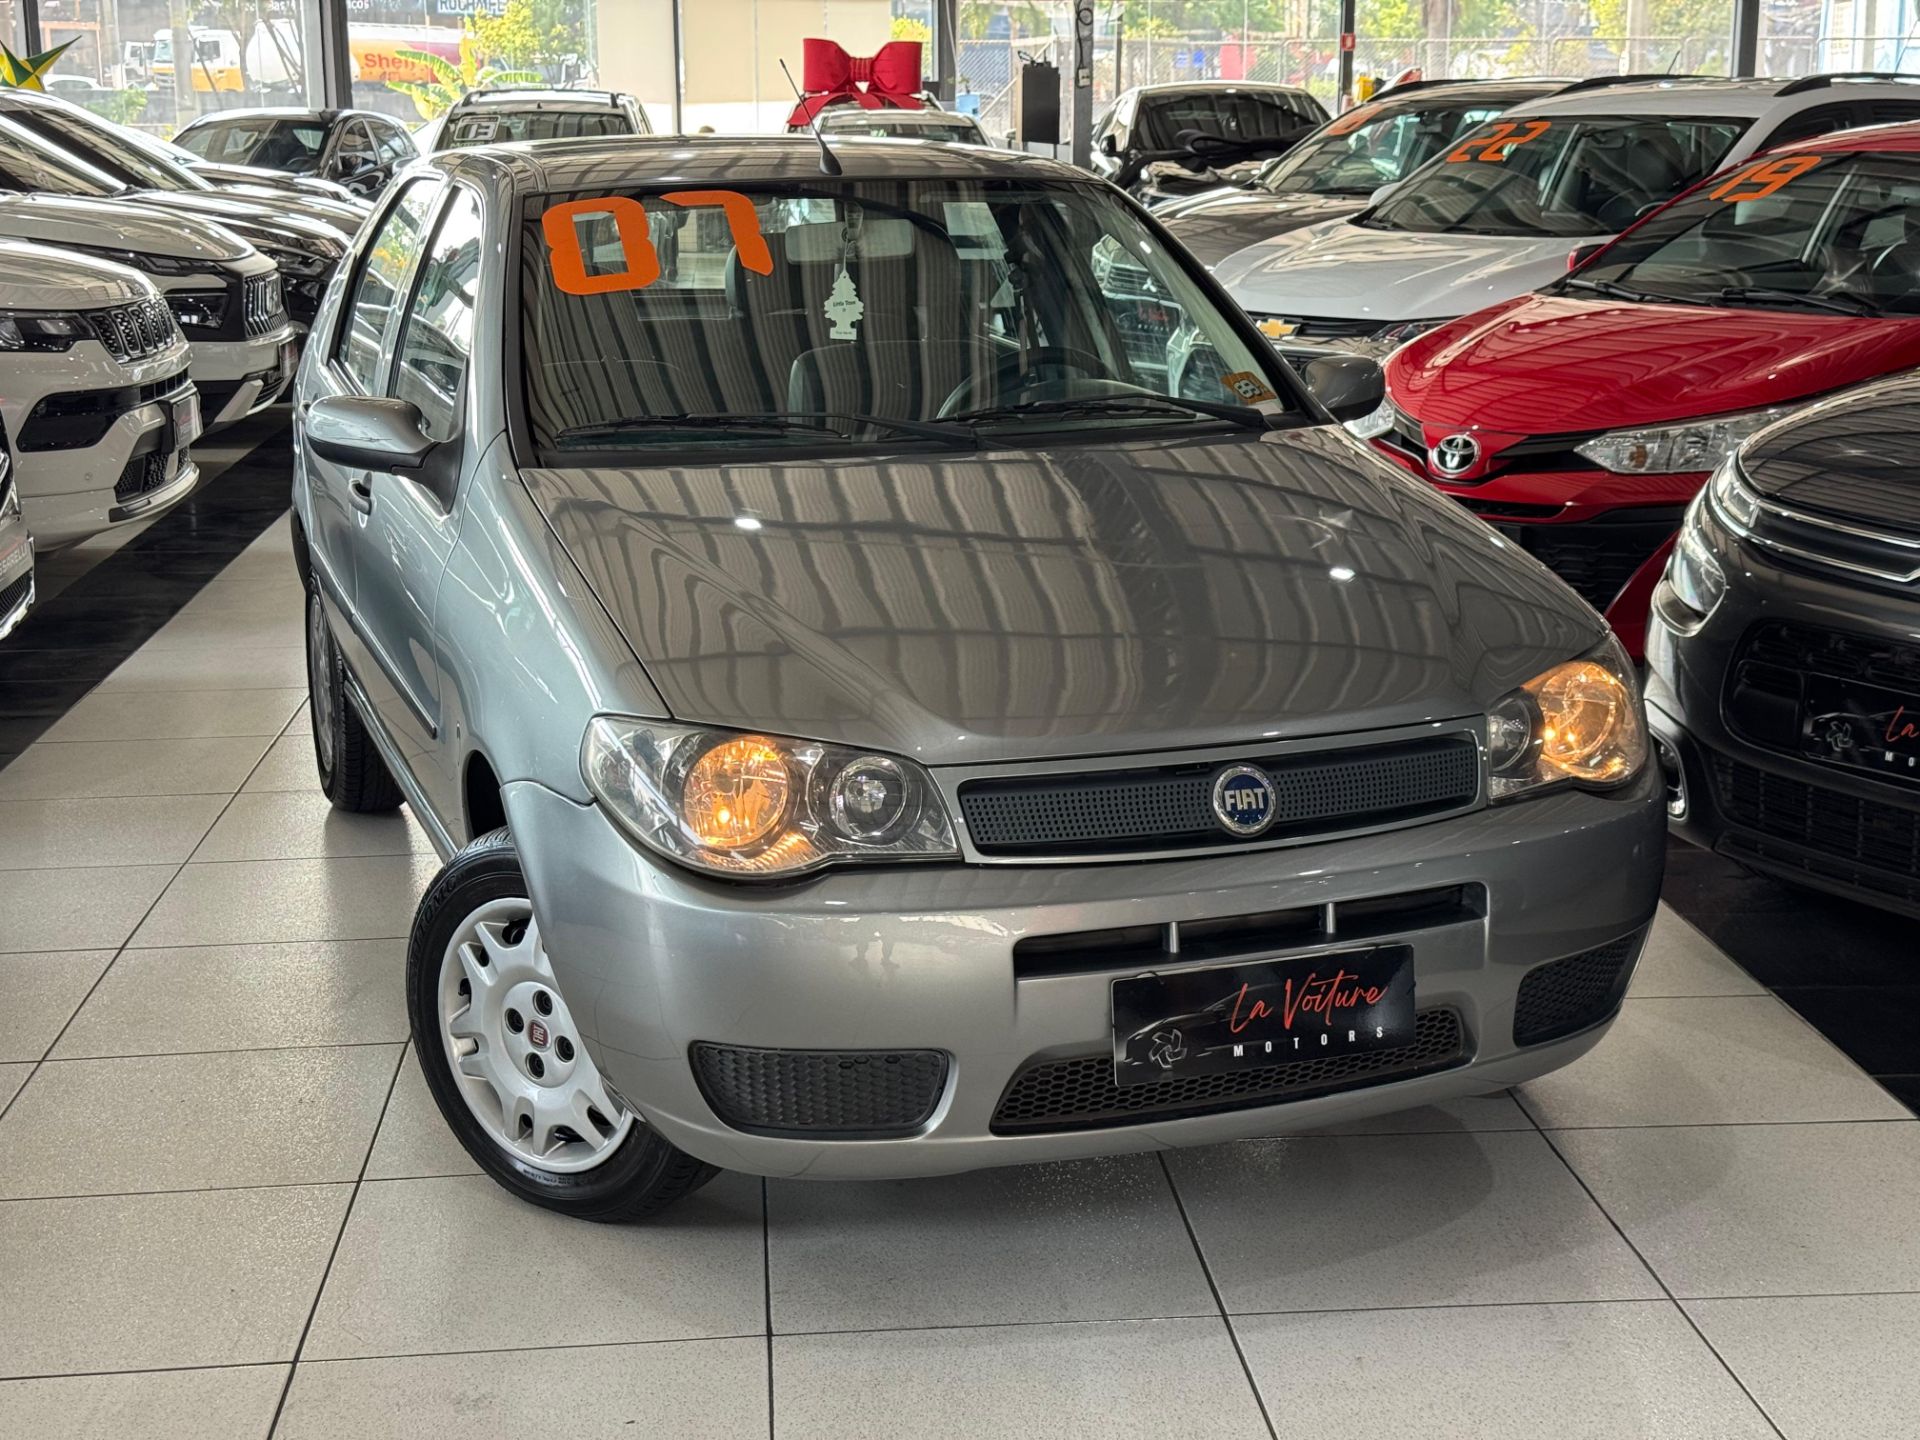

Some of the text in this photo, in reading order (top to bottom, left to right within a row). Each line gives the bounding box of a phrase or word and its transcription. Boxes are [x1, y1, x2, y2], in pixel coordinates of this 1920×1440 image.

[1446, 121, 1552, 163] 22
[1708, 155, 1821, 202] 19
[542, 190, 774, 295] 07
[1886, 705, 1920, 742] La
[1224, 788, 1265, 811] FIAT
[1229, 969, 1388, 1033] La Voiture
[533, 1024, 545, 1043] FIAT
[1233, 1026, 1384, 1057] MOTORS
